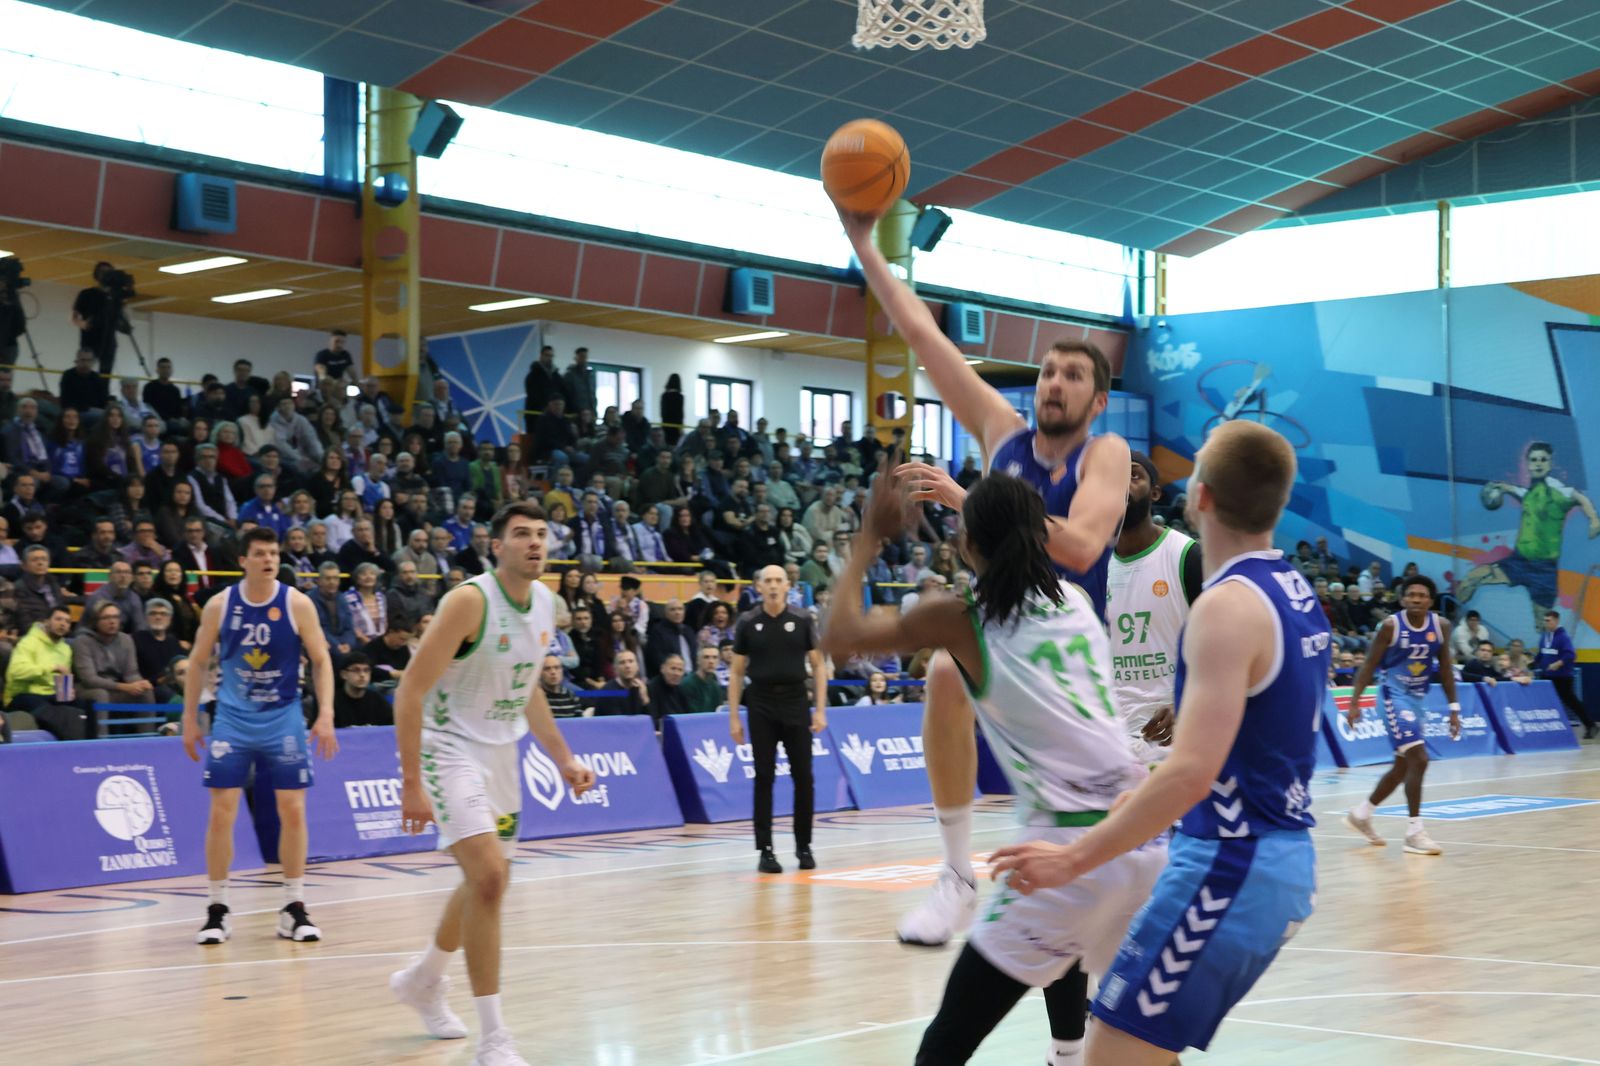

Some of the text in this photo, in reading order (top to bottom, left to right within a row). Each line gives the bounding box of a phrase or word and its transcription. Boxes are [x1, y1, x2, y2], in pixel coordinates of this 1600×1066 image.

[240, 623, 271, 646] 20
[1117, 611, 1152, 645] 97
[1112, 652, 1167, 669] AMICS
[1407, 643, 1429, 660] 22
[1113, 663, 1177, 682] ASTELLO
